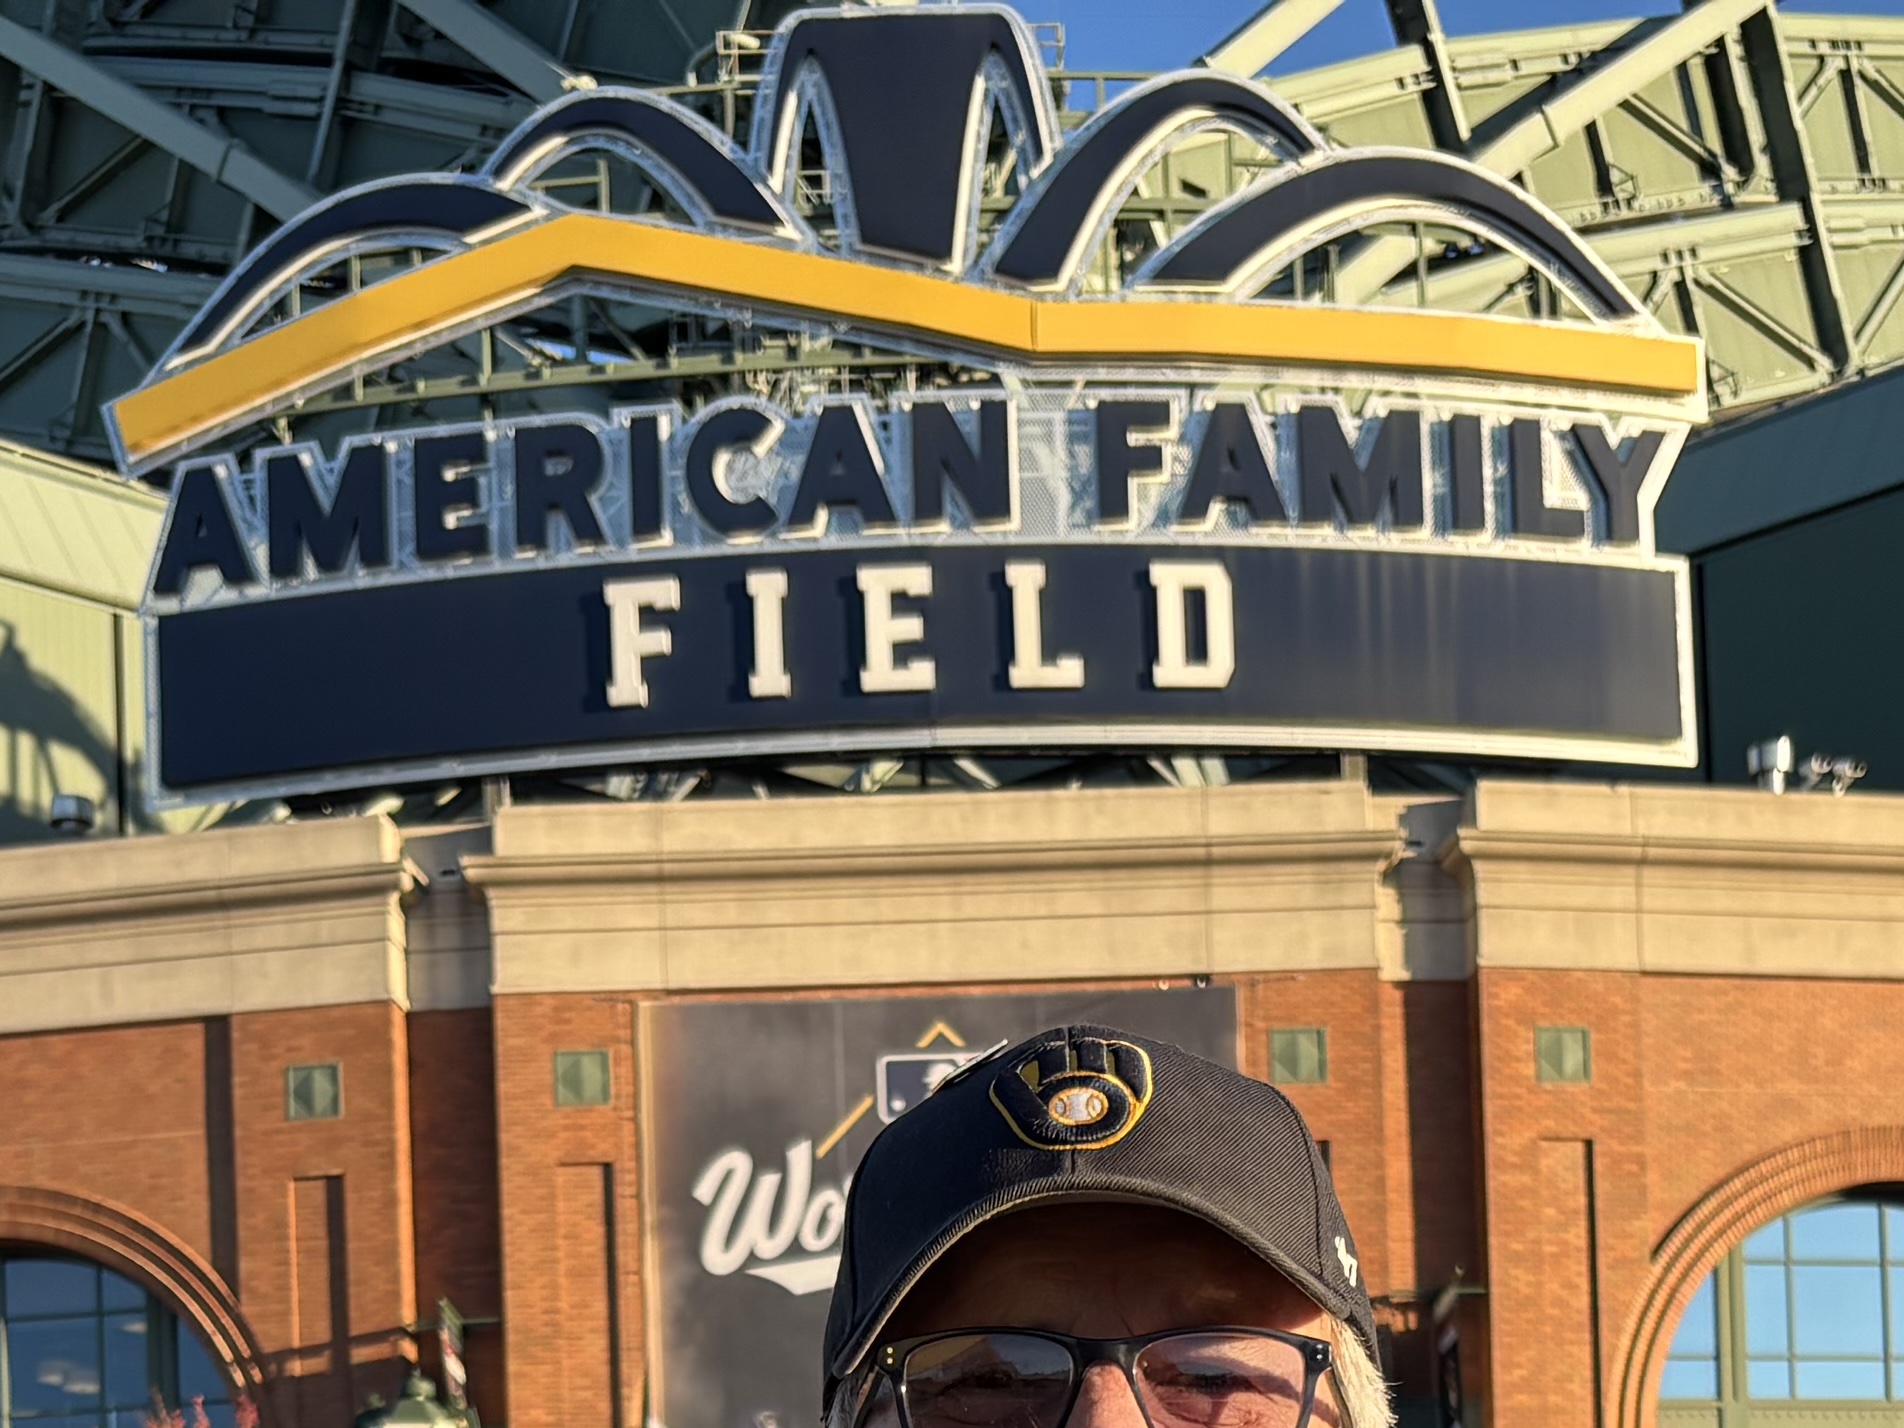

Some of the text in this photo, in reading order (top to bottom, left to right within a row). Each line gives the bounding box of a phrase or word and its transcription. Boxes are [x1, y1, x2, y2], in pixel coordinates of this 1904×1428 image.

[153, 397, 1666, 595] AMERICAN FAMILY
[603, 559, 1236, 709] FIELD
